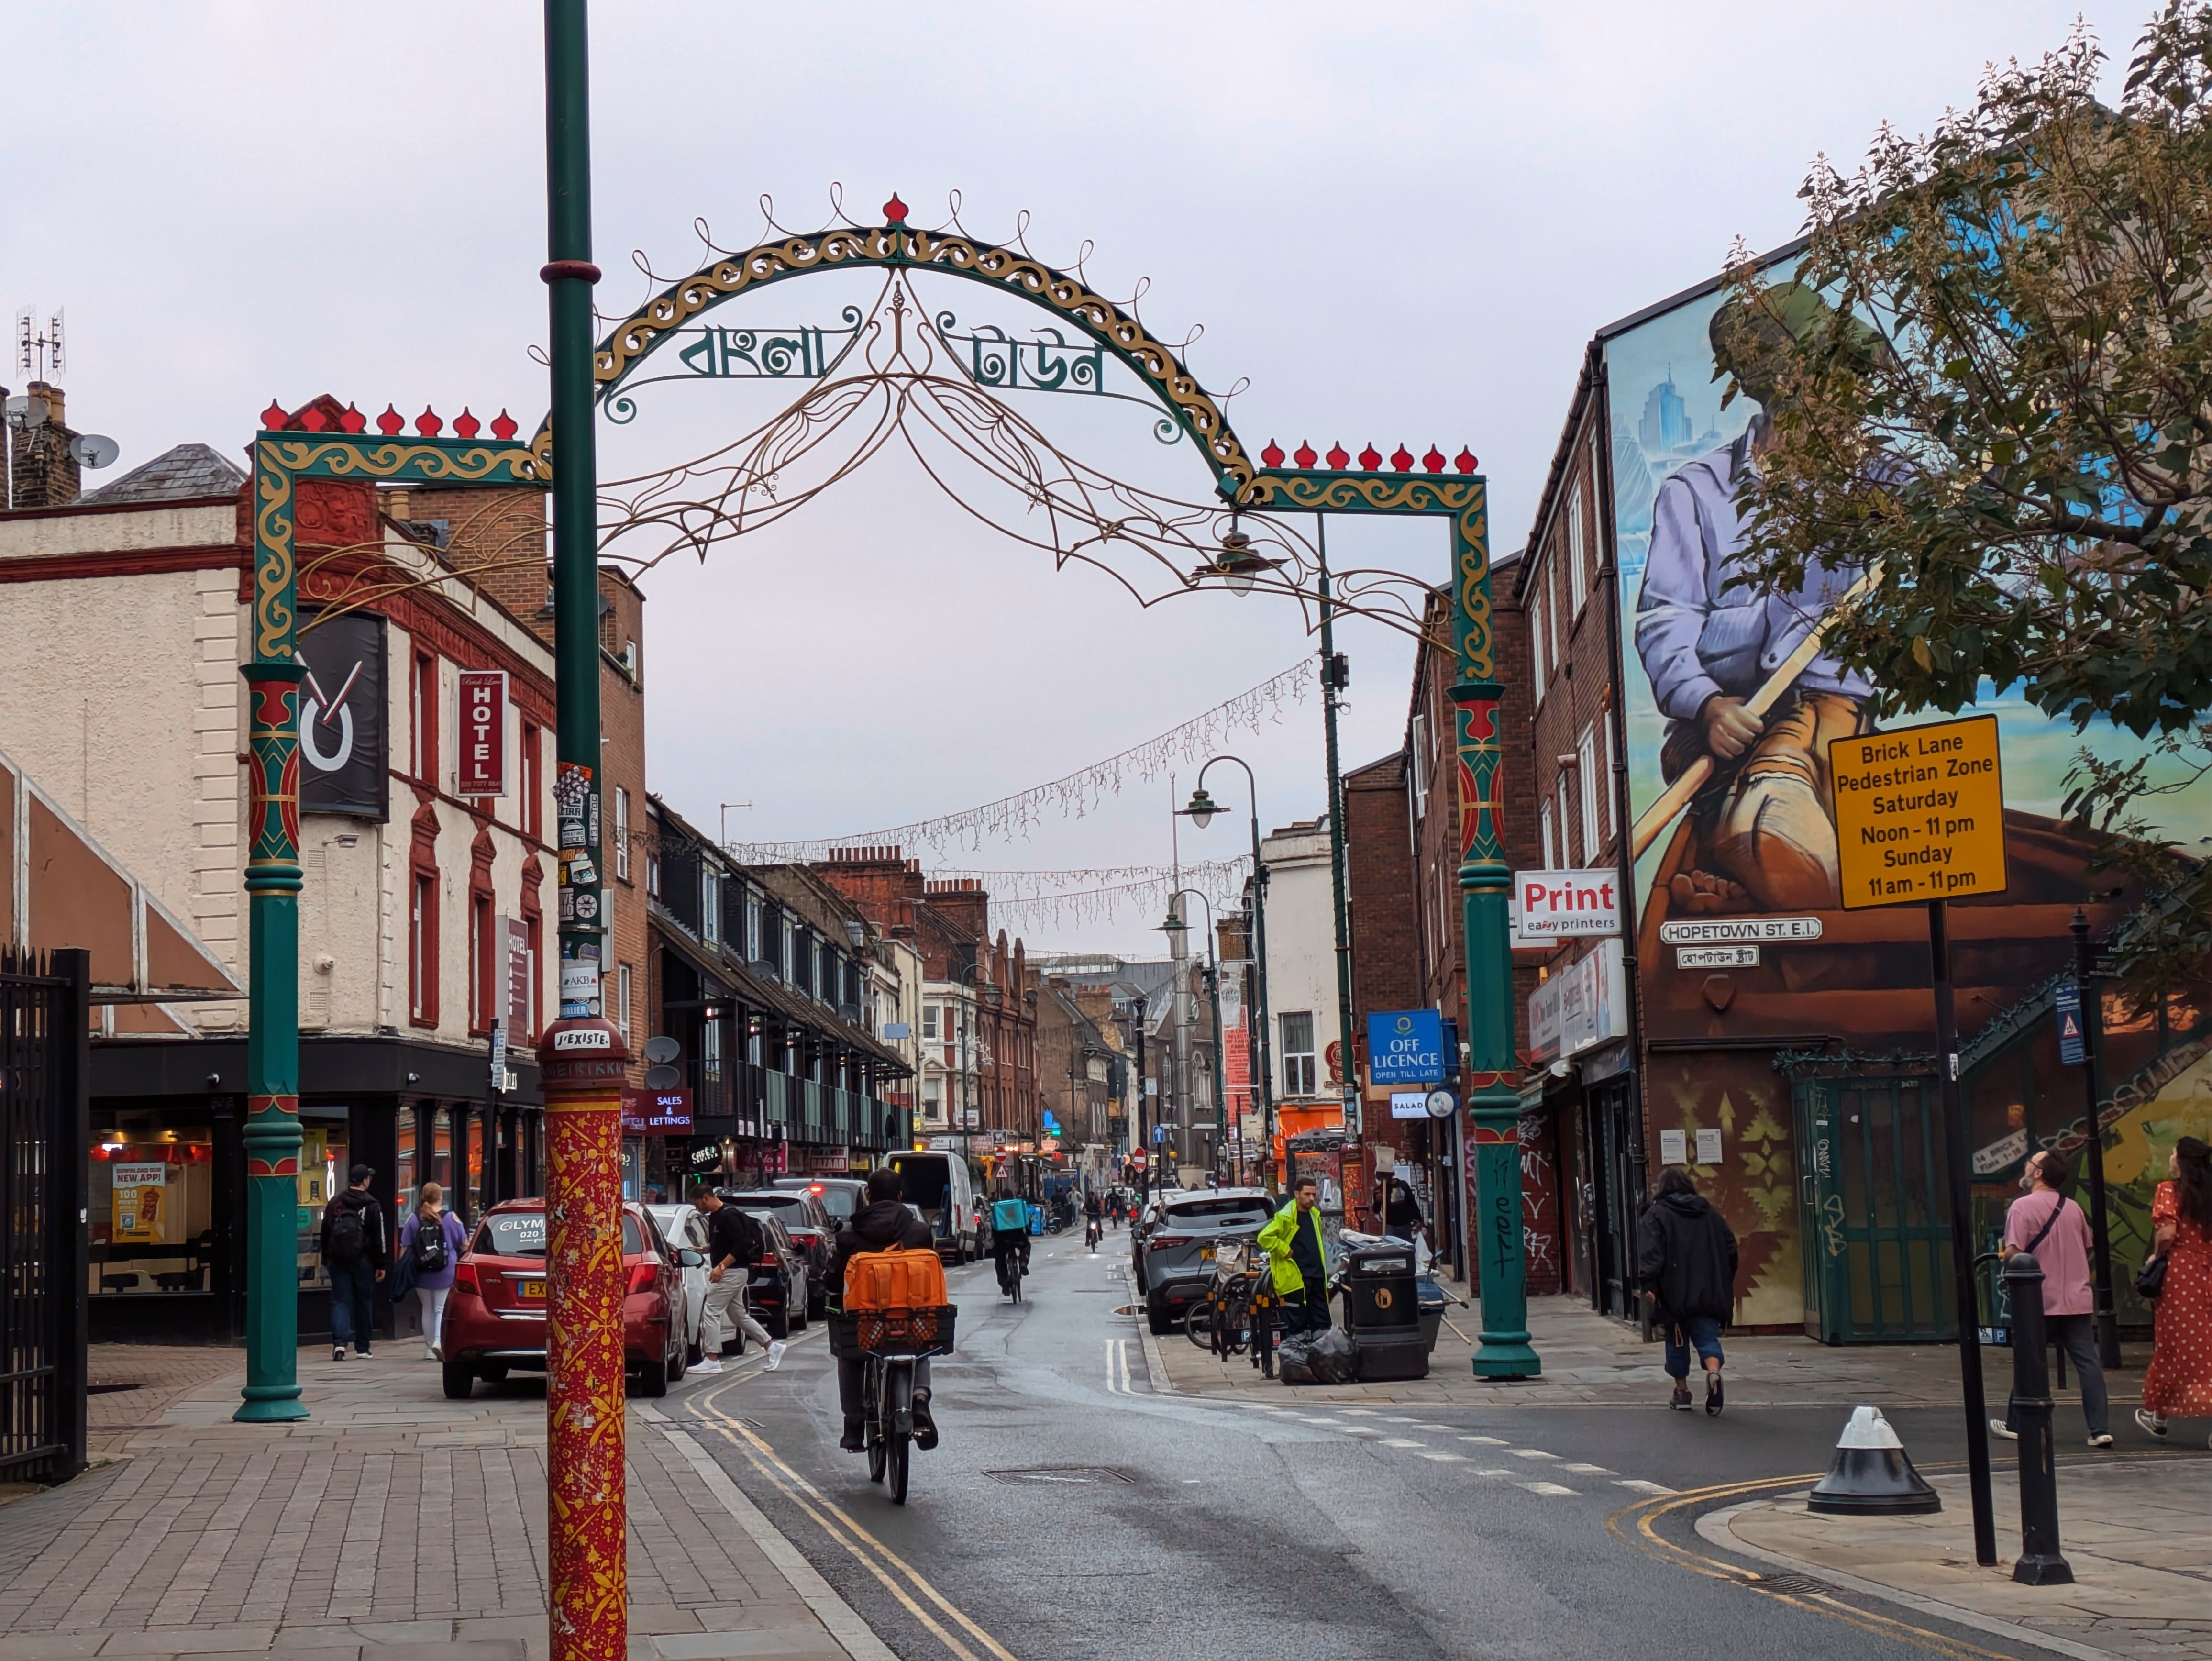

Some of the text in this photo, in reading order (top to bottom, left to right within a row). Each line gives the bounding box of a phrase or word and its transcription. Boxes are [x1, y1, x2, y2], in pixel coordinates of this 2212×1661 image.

[679, 325, 1103, 394] বাংলা টাউন
[473, 687, 491, 778] HOTEL
[1861, 736, 1964, 764] Brick Lane
[1837, 758, 1993, 793] Pedestrian Zone
[1873, 789, 1958, 815] Saturday
[1861, 826, 1909, 845] Noon
[1884, 845, 1953, 868] Sunday
[1526, 881, 1615, 912] Print
[1528, 918, 1615, 932] eazy printers
[1669, 924, 1759, 940] HOPETOWN
[1766, 923, 1786, 936] ST.
[509, 933, 526, 955] HOTEL
[570, 976, 589, 985] AKB
[557, 1033, 608, 1046] J'EXISTE.
[1390, 1039, 1420, 1052] OFF
[1374, 1053, 1438, 1068] LICENCE
[1375, 1071, 1396, 1079] OPEN
[657, 1096, 682, 1105] SALES
[650, 1116, 690, 1125] LETTINGS
[811, 1159, 844, 1169] BAZAAR
[140, 1174, 161, 1182] APP!
[120, 1190, 137, 1199] 100
[500, 1219, 546, 1231] OLYM
[1996, 1330, 2004, 1341] P
